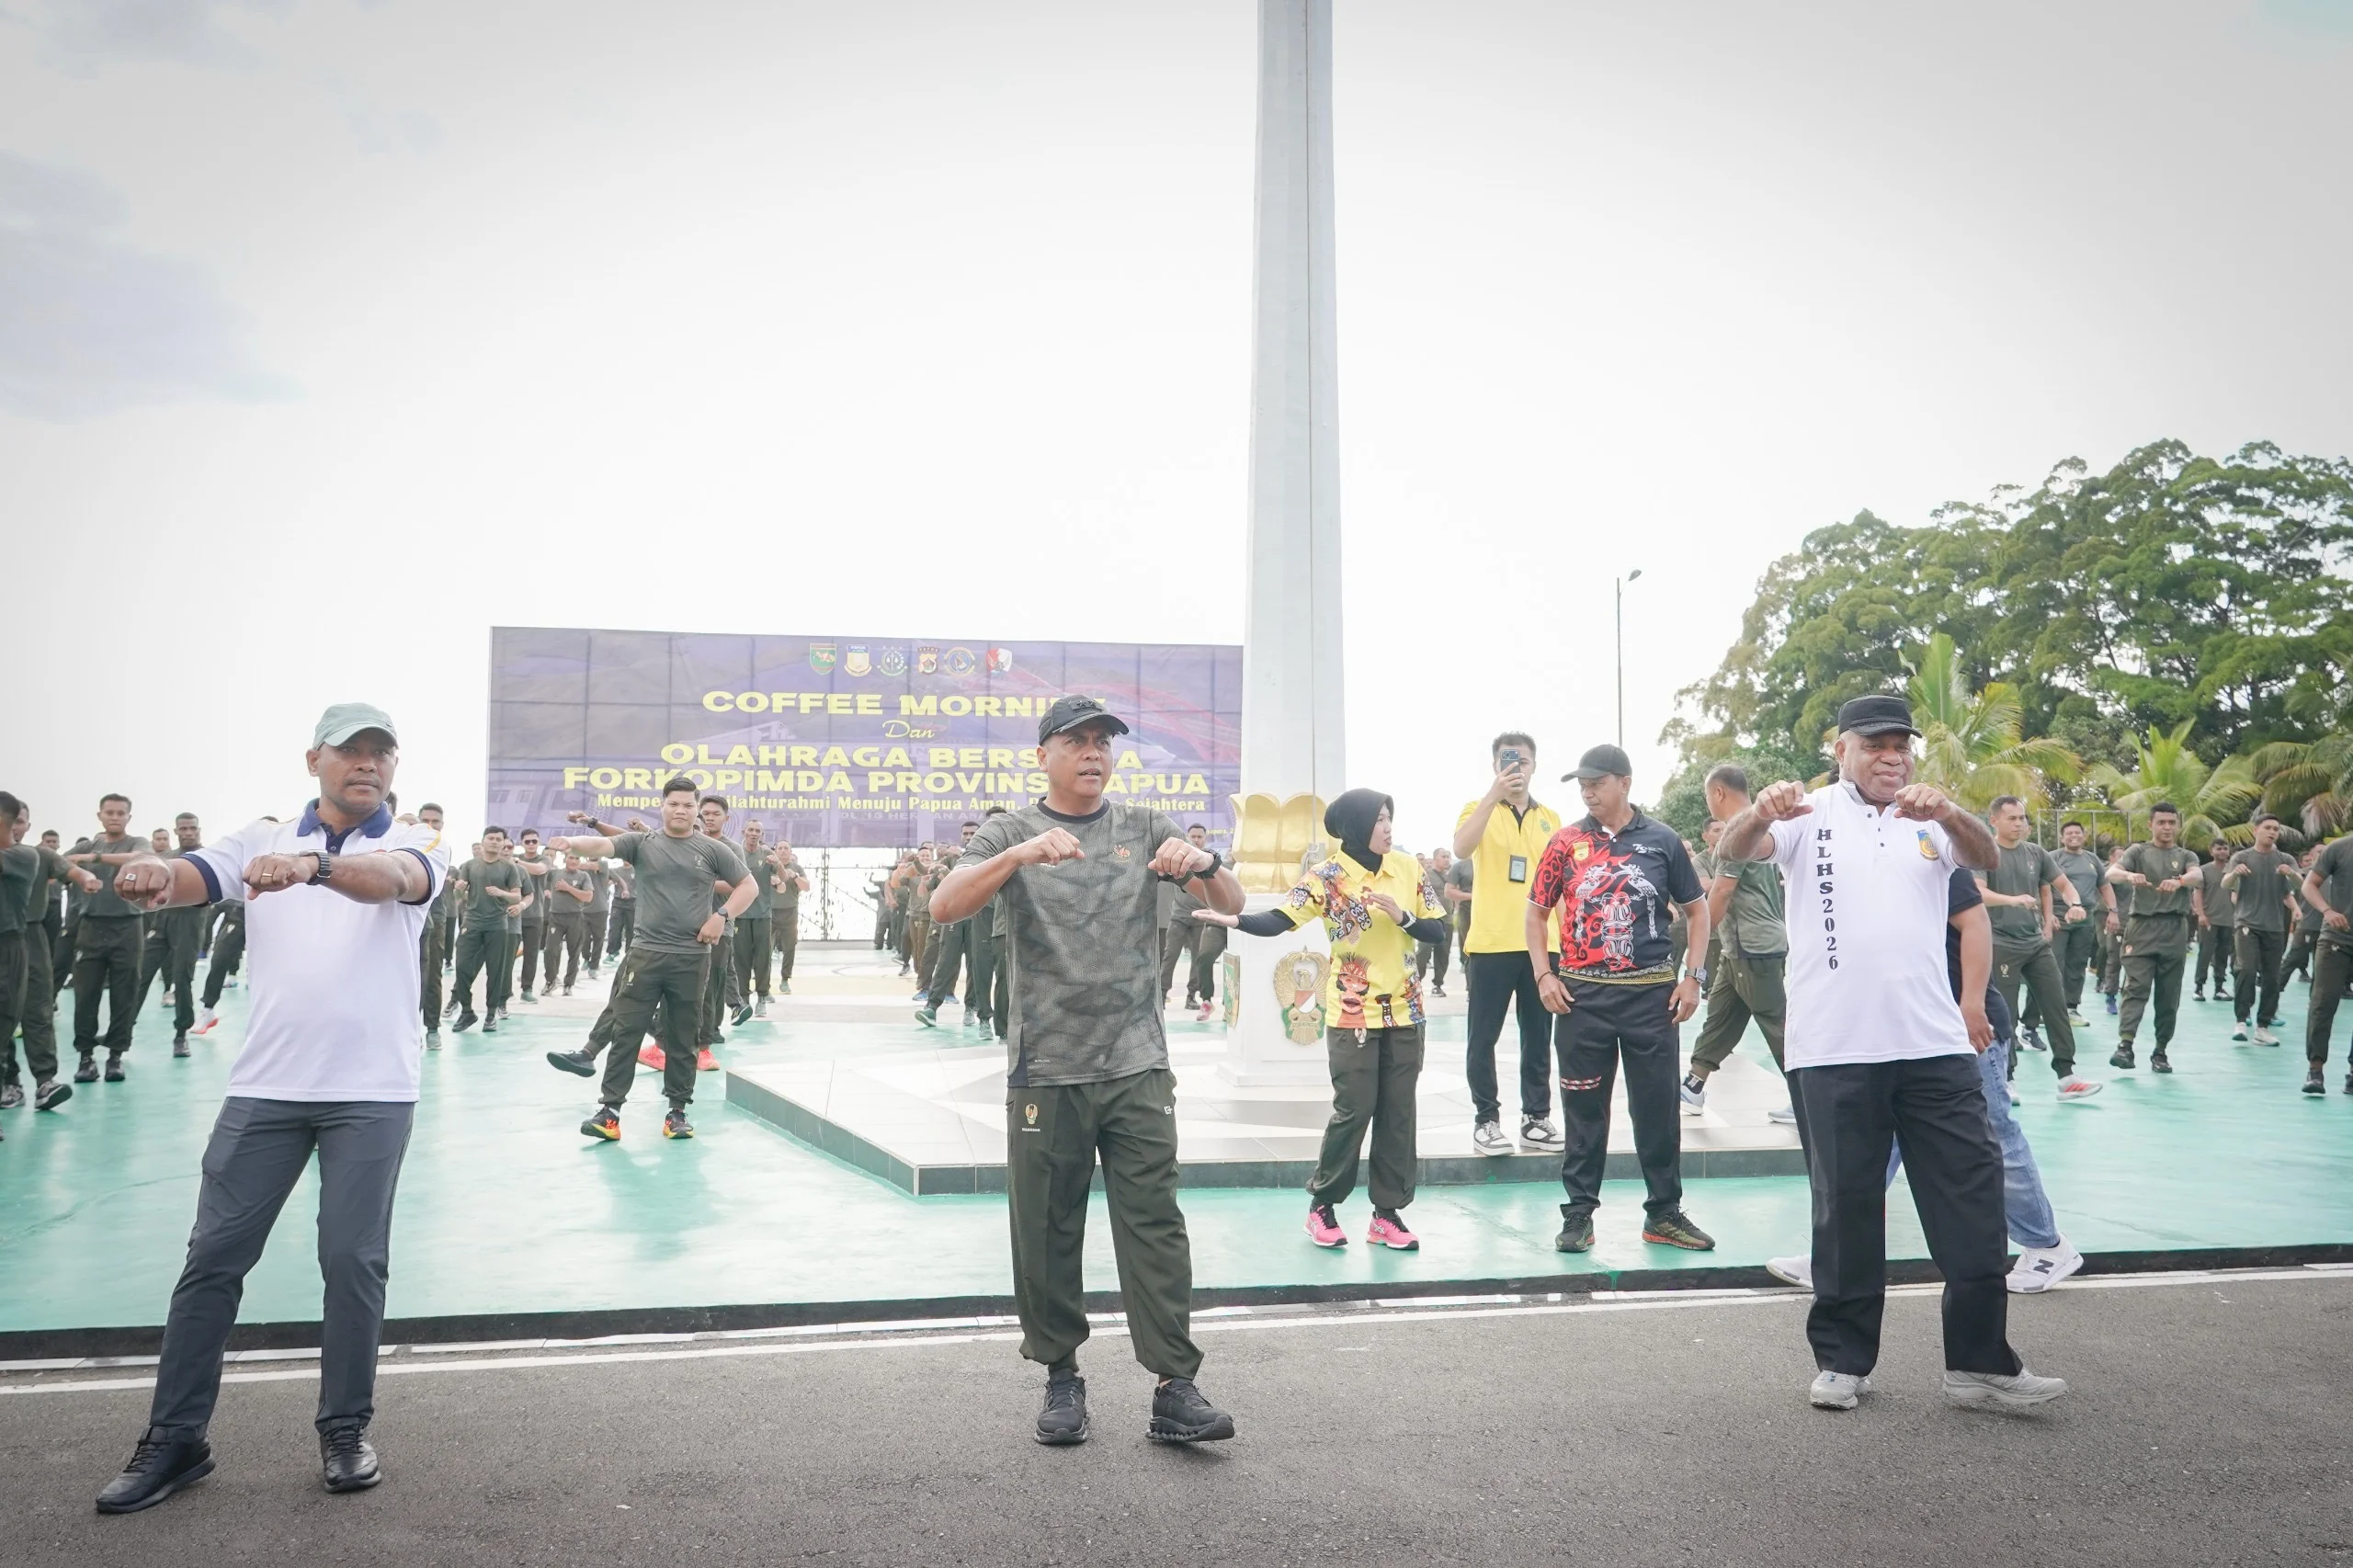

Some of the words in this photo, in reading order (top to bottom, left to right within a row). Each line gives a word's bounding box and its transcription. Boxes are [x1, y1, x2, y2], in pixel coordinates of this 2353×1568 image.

[701, 690, 882, 715] COFFEE
[898, 694, 1107, 717] MORNI
[881, 720, 936, 740] Dan
[660, 743, 912, 769] OLAHRAGA
[928, 747, 1144, 770] BERSA
[563, 766, 855, 793] FORKOPIMDA
[868, 771, 1049, 794] PROVINS
[1102, 773, 1211, 795] APUA
[727, 794, 830, 810] ilahturahmi
[837, 796, 902, 812] Menuju
[908, 797, 963, 812] Papua
[1816, 828, 1838, 971] HLHS2026
